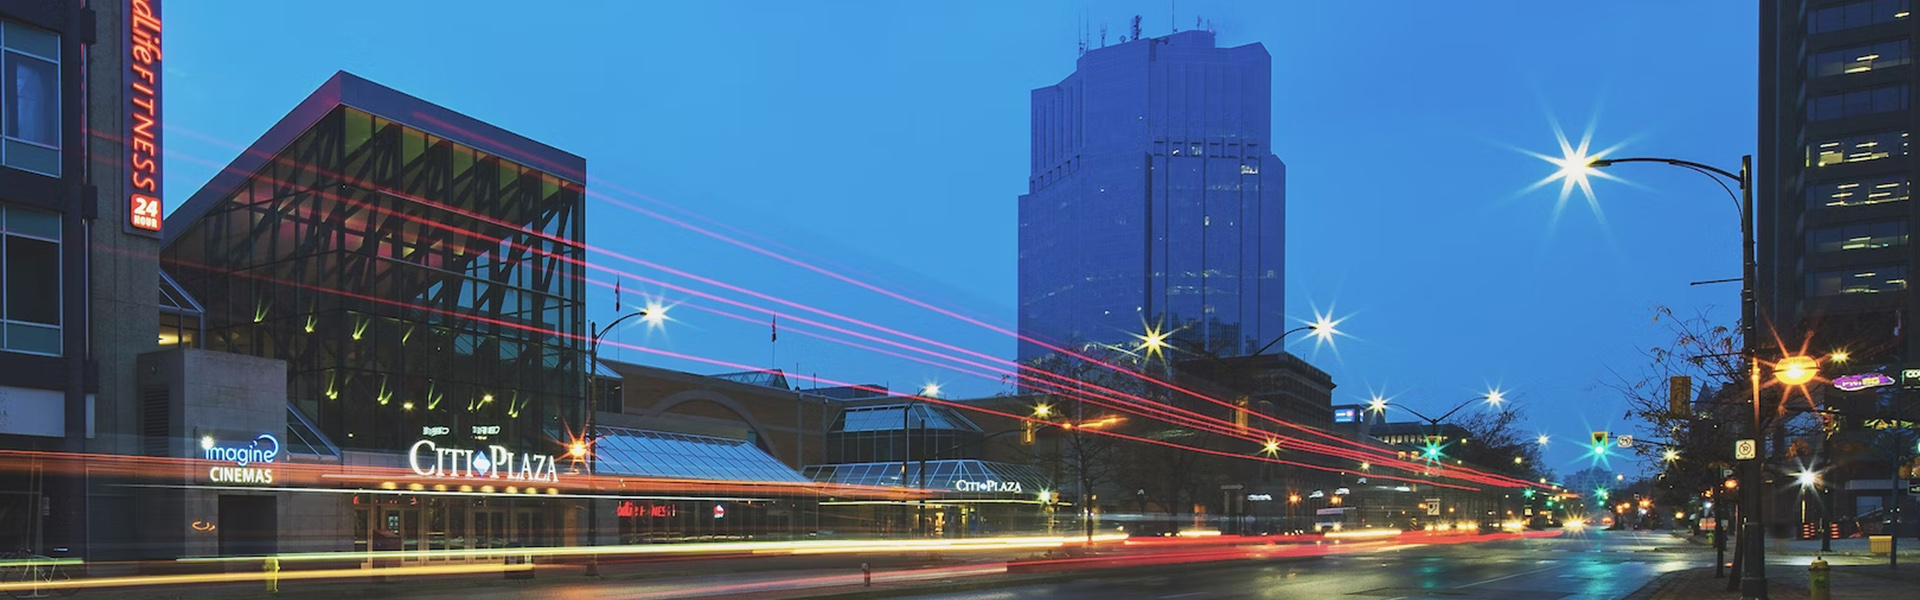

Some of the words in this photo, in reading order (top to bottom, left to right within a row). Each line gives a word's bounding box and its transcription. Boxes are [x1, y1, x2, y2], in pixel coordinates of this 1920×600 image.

[132, 0, 162, 64] dLife
[132, 64, 155, 192] FITNESS
[134, 198, 158, 217] 24
[133, 215, 158, 228] HOUR
[201, 433, 279, 467] imagine
[409, 439, 474, 478] CITI
[489, 445, 559, 483] PLAZA
[209, 466, 273, 484] CINEMAS
[956, 479, 980, 492] CITI
[986, 479, 1023, 494] PLAZA
